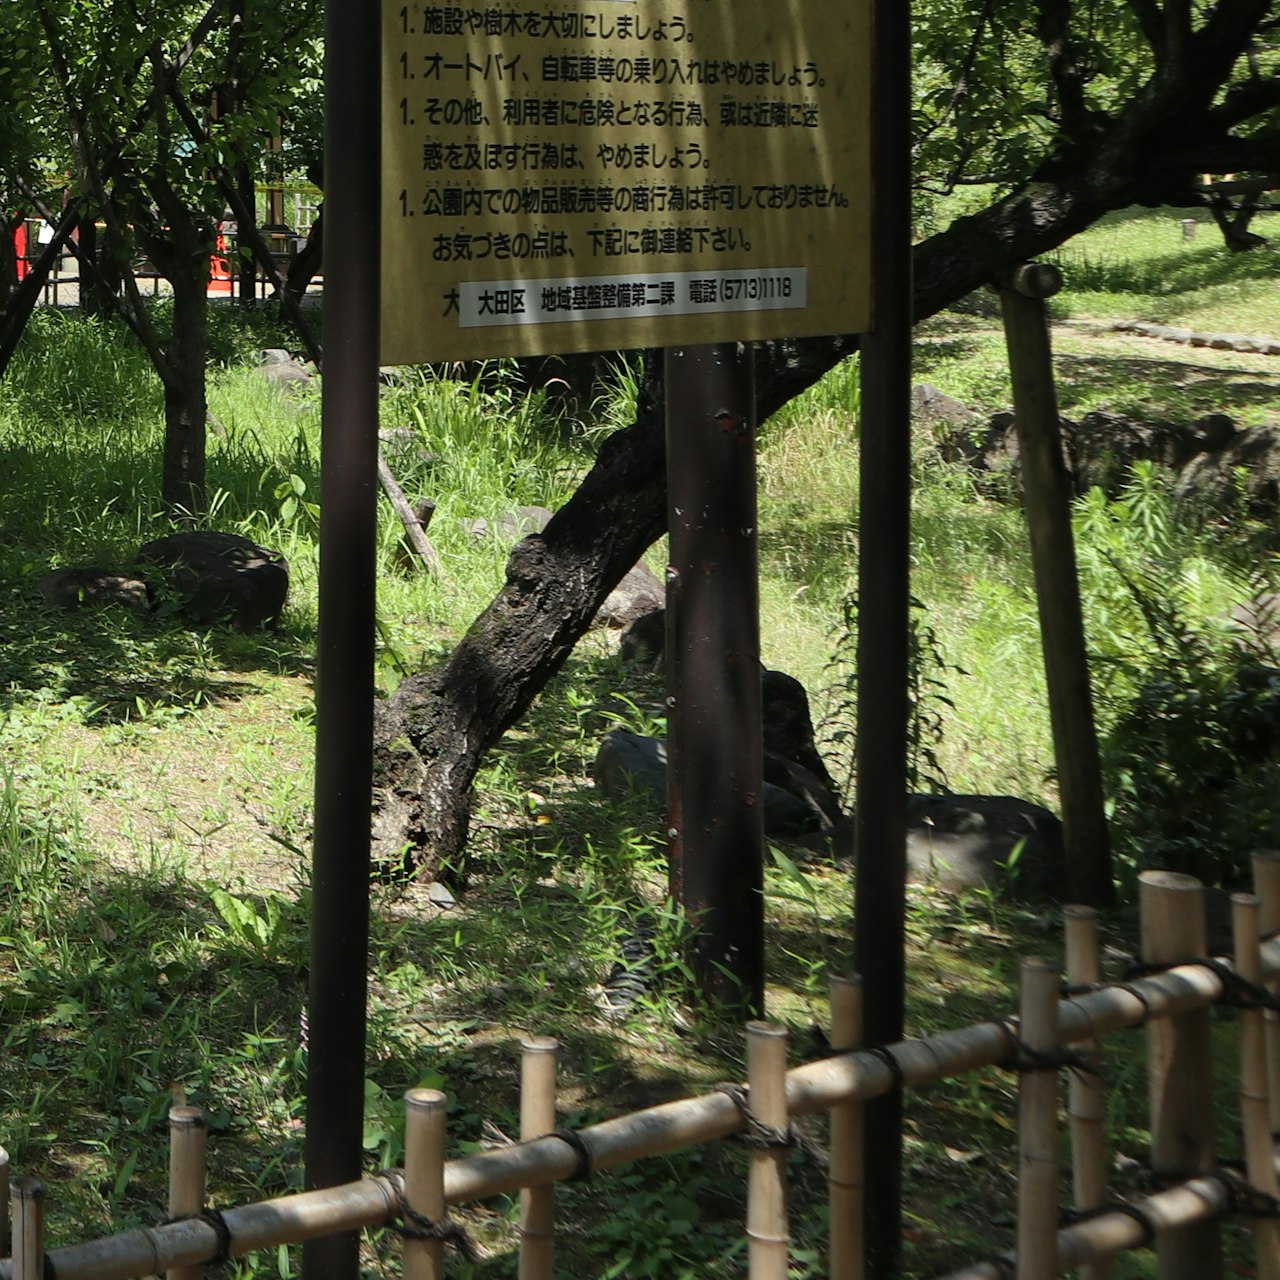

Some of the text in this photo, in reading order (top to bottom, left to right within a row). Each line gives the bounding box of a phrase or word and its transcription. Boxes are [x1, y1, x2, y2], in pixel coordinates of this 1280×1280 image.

[399, 6, 694, 43] 1. 施設や樹木を大切にしましょう。
[399, 52, 826, 88] 1. オートバイ、自転車等の乗り入れはやめましょう。
[399, 97, 819, 128] 1. その他、利用者に危険となる行為、或は近隣に迷
[422, 142, 710, 171] 惑を及ぼす行為は、やめましょう。
[398, 184, 850, 217] 1. 公園内での物品販売等の商行為は許可しておりません。
[432, 225, 752, 262] お気づきの点は、下記に御連絡下さい。
[477, 289, 527, 316] 大田区
[540, 281, 676, 312] 地域基盤整備第二課
